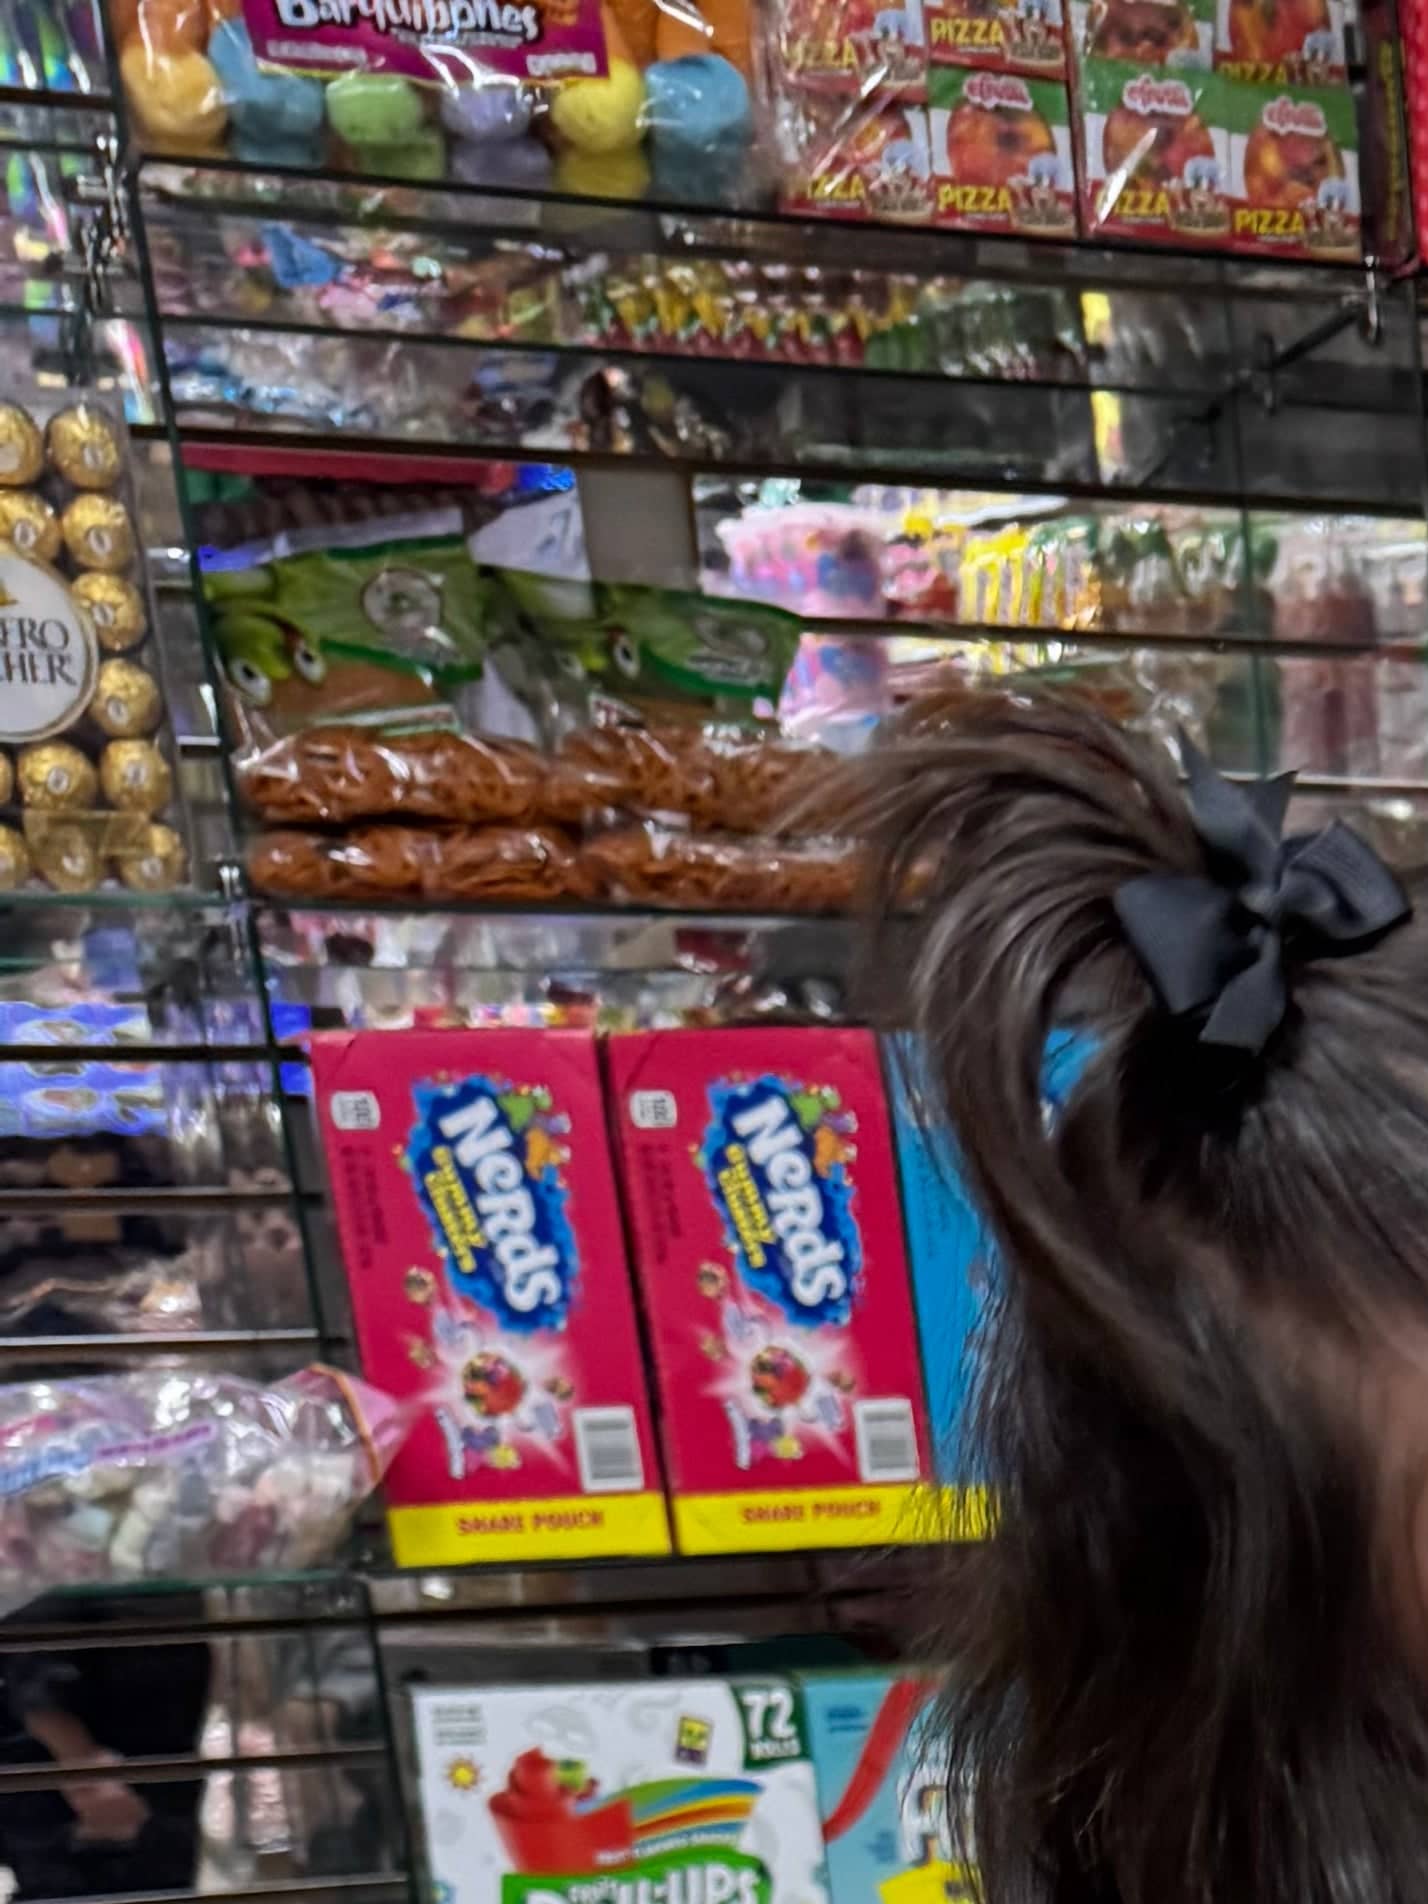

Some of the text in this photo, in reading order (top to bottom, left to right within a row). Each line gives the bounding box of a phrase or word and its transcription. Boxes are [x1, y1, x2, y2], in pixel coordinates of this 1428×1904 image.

[931, 18, 1004, 44] PIZZA
[938, 185, 1011, 214] PIZZA
[1236, 208, 1304, 234] PIZZA
[439, 1096, 560, 1314] Nerds
[730, 1096, 846, 1310] Nerds
[745, 1691, 797, 1743] 72
